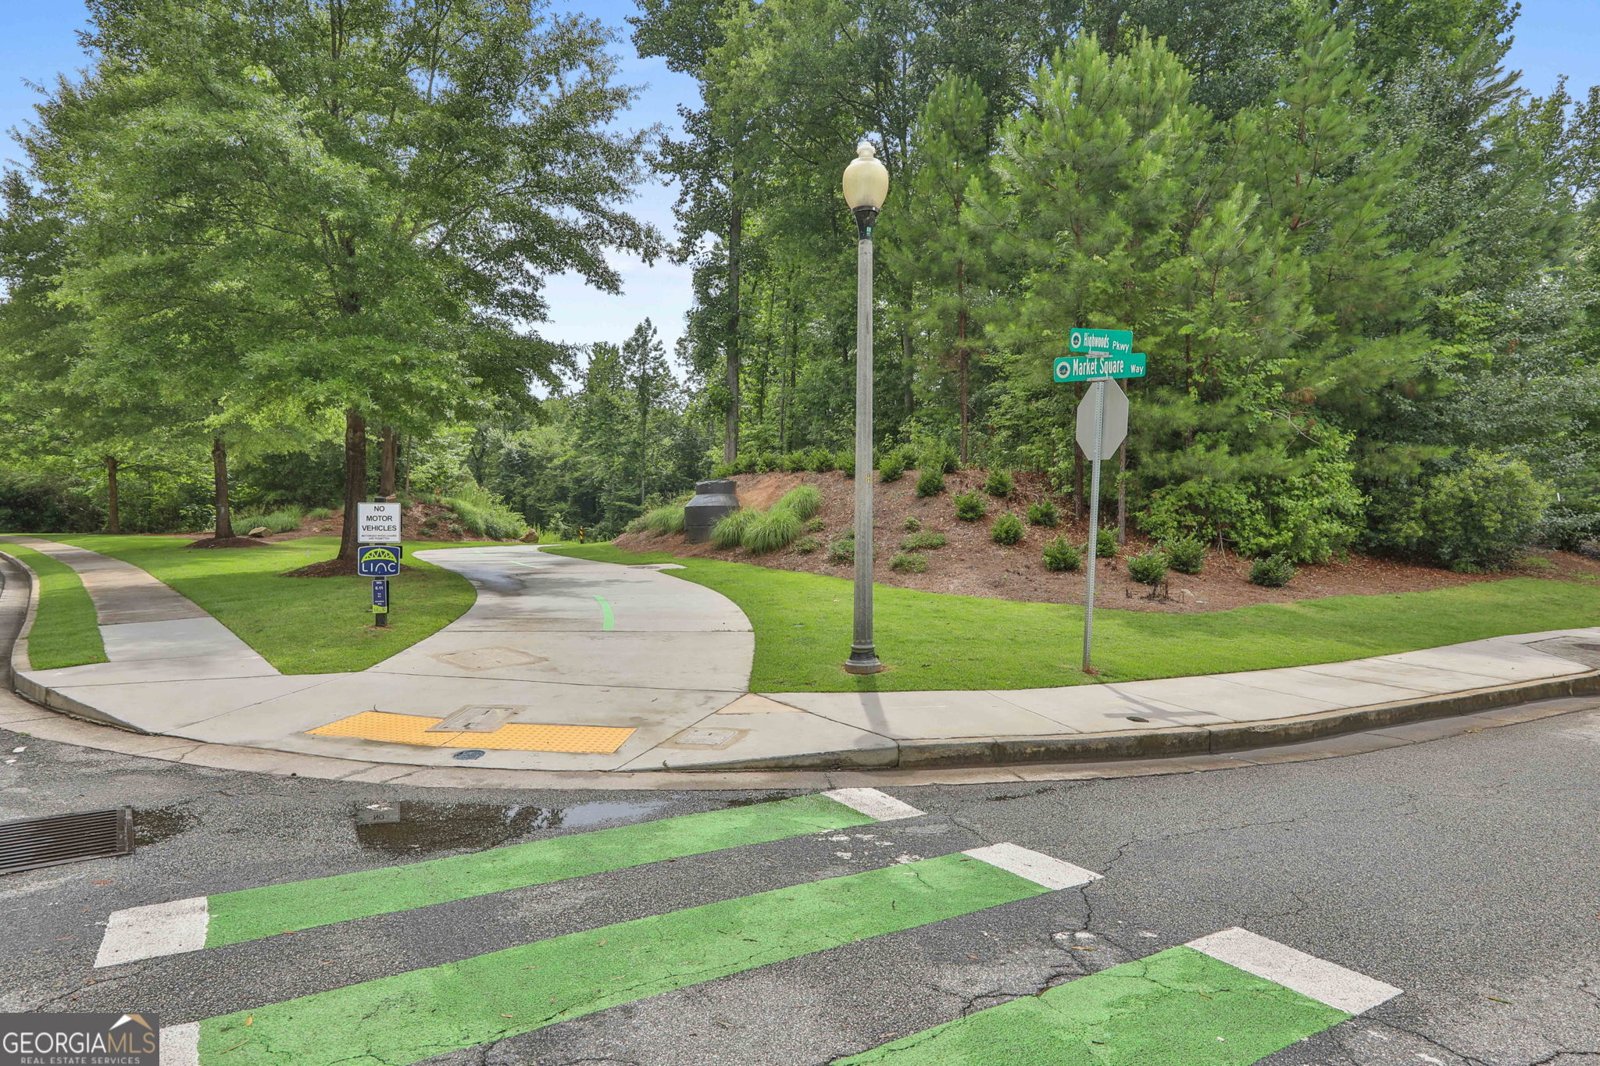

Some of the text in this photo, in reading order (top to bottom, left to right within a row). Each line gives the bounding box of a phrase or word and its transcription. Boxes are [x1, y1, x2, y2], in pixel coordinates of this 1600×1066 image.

[1084, 332, 1130, 353] Highwoods Pkwy
[1072, 357, 1144, 377] Market Square Way
